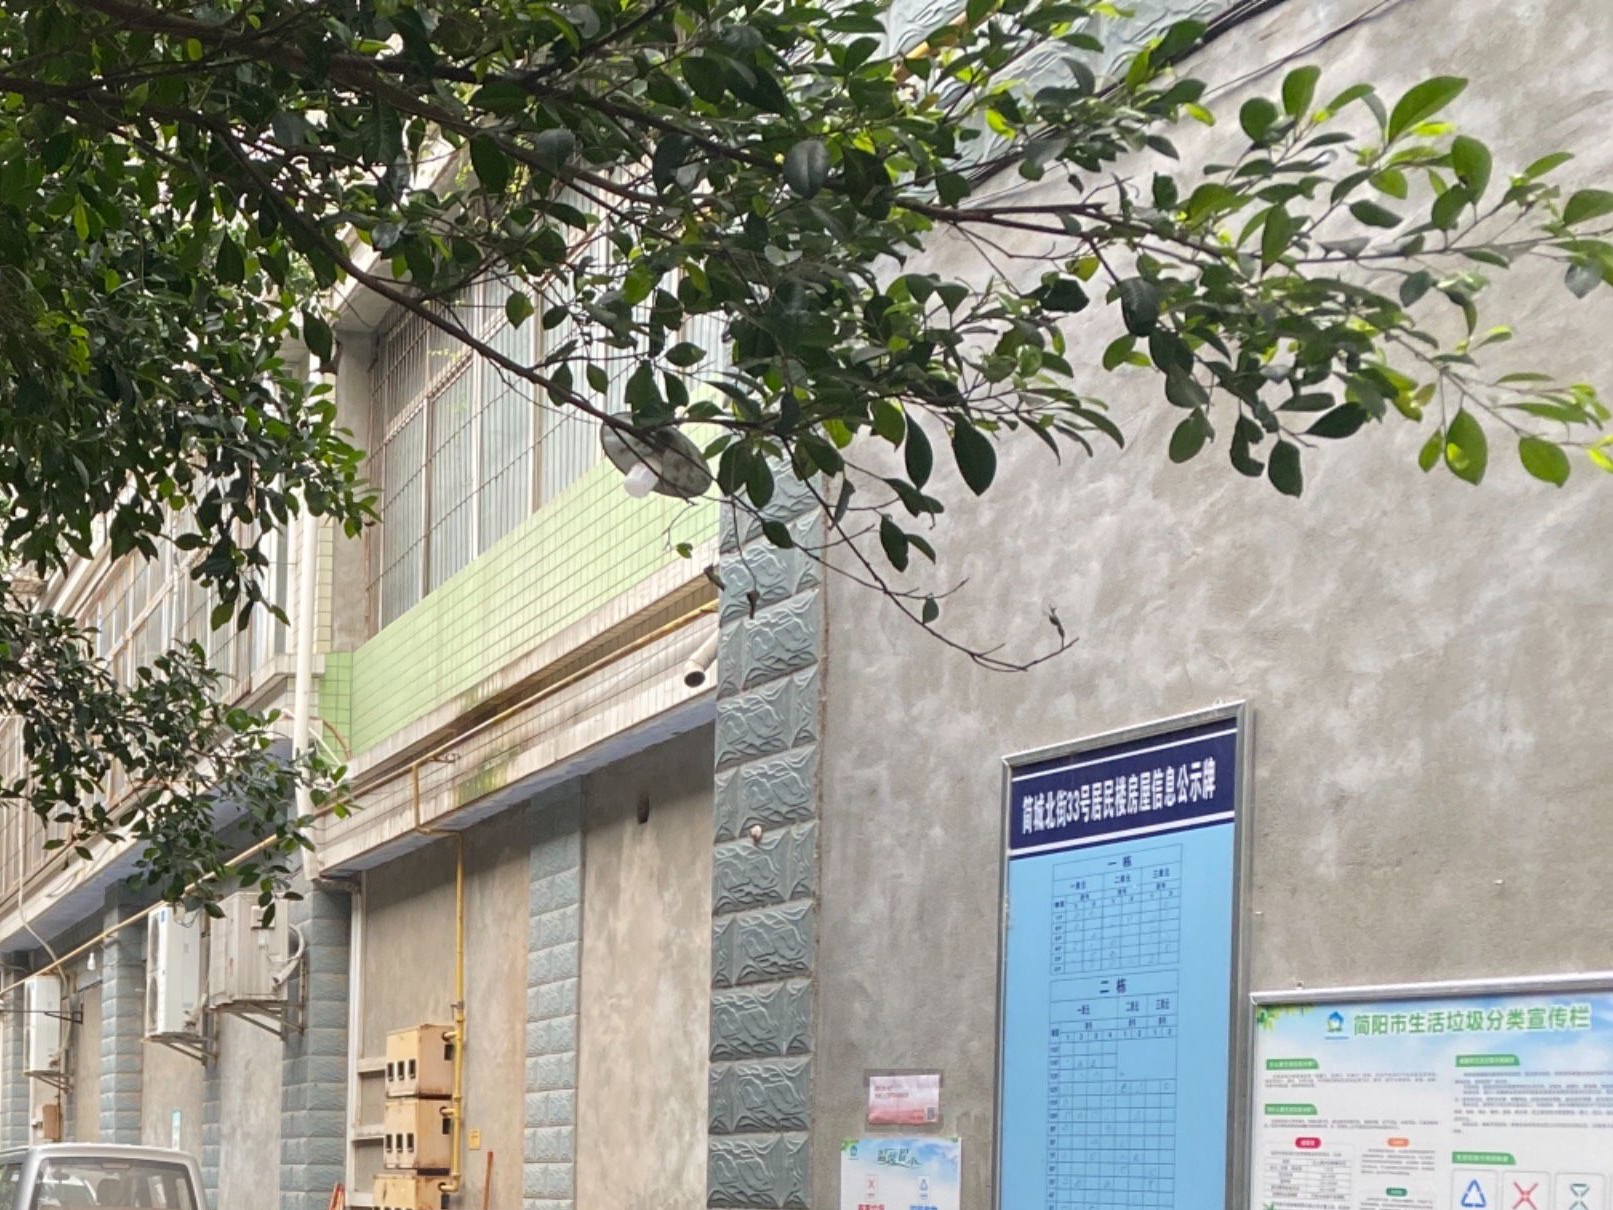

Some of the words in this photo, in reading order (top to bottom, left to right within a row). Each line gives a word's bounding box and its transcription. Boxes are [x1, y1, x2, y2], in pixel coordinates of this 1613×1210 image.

[1022, 757, 1216, 834] 简城北街33号居民楼房屋信息公示牌
[1354, 1006, 1590, 1036] 简阳市生活垃圾分类宣传栏
